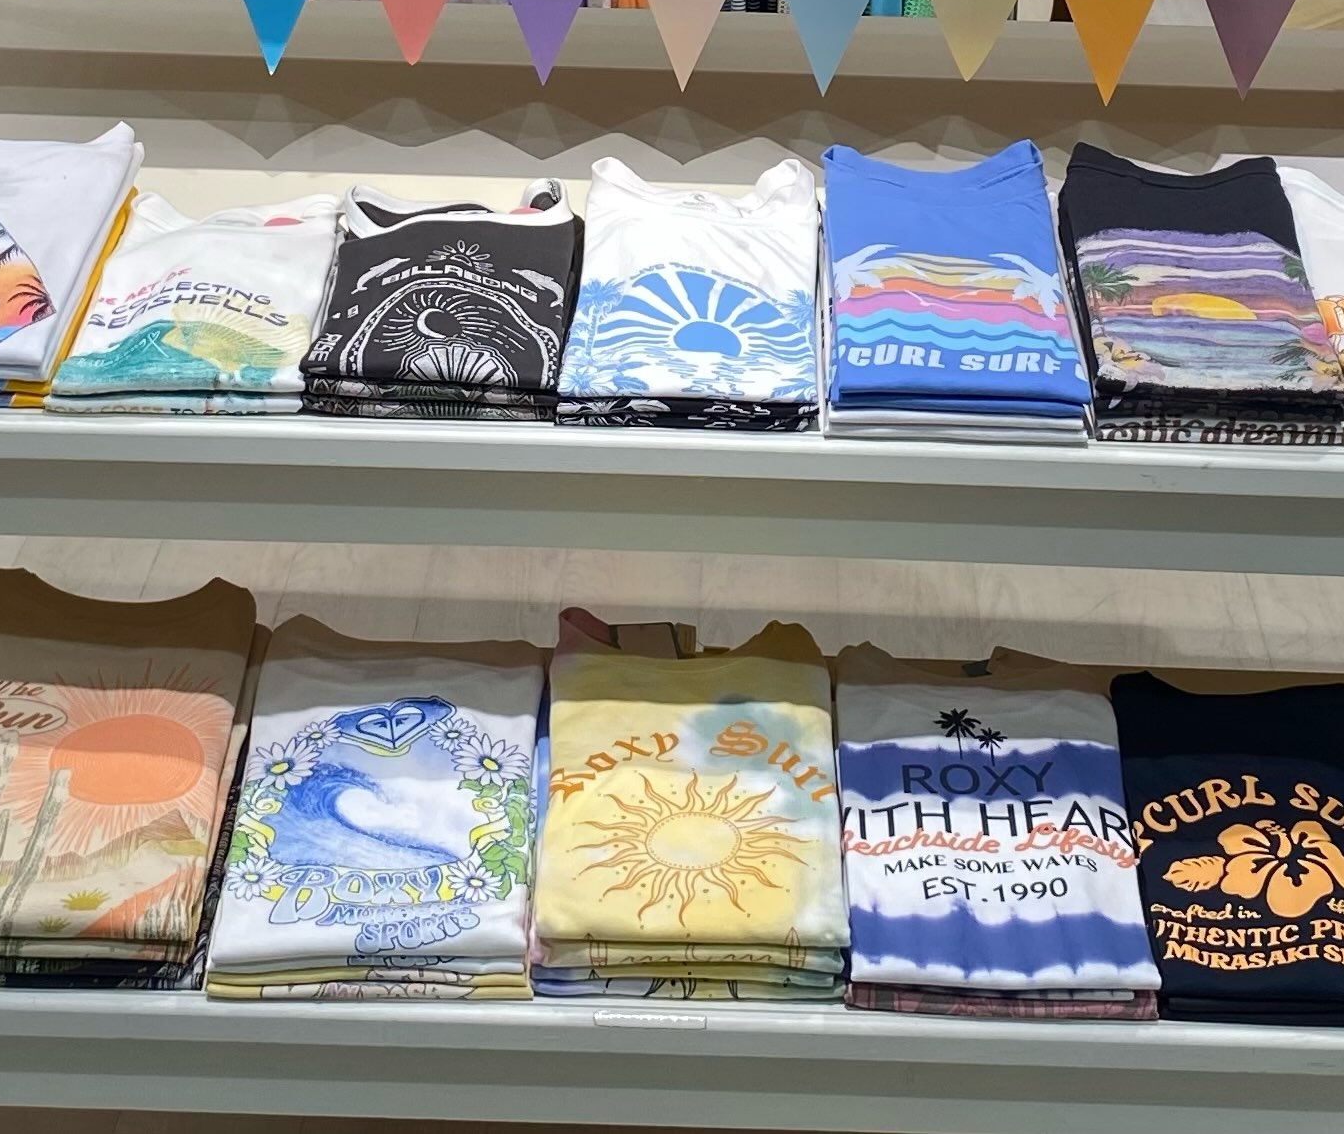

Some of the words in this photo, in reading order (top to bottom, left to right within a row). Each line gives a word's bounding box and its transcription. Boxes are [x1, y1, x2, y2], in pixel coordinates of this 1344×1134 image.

[111, 280, 272, 316] COLLECTING
[126, 281, 158, 302] ART
[167, 267, 193, 282] OF
[380, 264, 539, 303] BILLABONG
[88, 293, 290, 330] SEASHELLS
[847, 343, 945, 369] CURL
[960, 351, 1061, 375] SURF
[9, 681, 46, 697] be
[902, 761, 1054, 796] ROXY
[1143, 774, 1277, 835] CURL
[884, 854, 947, 877] MAKE
[954, 857, 1015, 875] SOME
[1022, 853, 1098, 874] WAVES
[354, 906, 481, 954] SPORTS
[1237, 906, 1262, 920] in
[1163, 941, 1320, 971] MURASAKI
